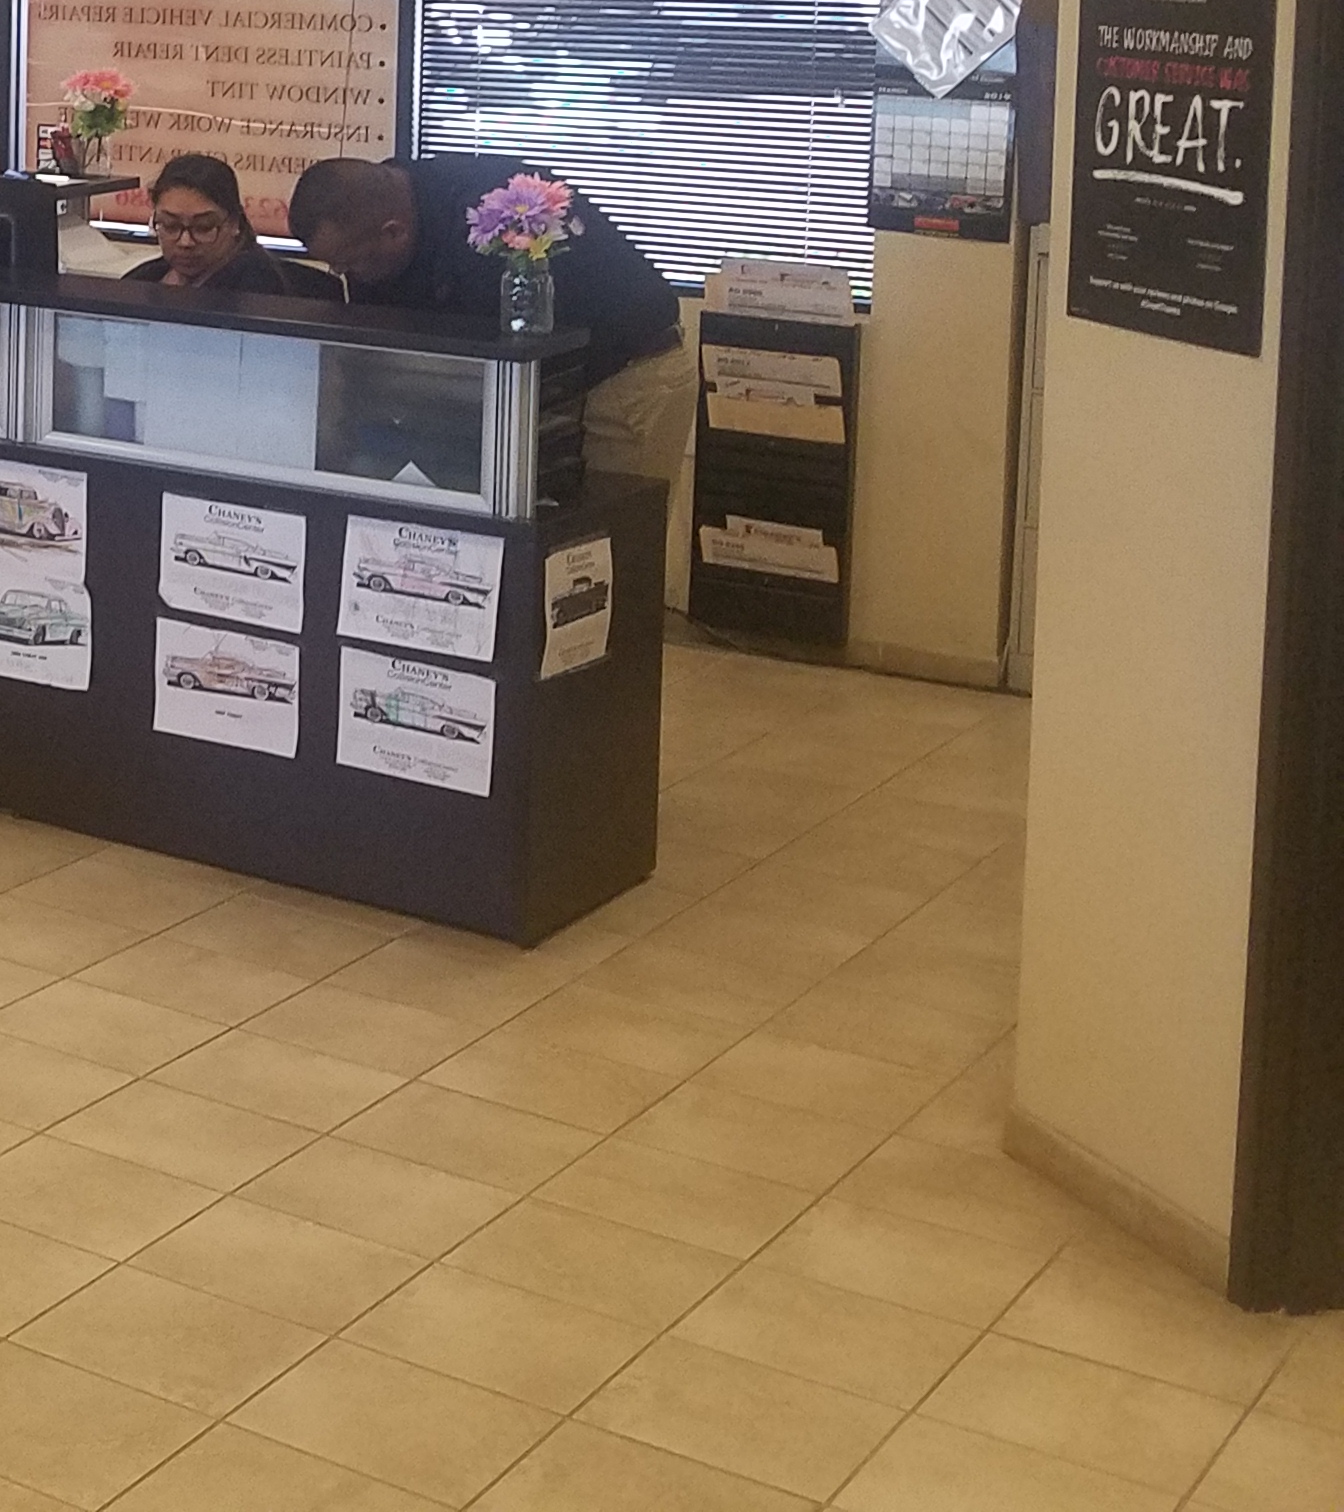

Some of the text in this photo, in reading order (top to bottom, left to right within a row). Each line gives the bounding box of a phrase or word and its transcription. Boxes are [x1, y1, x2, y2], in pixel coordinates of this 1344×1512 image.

[1098, 25, 1254, 60] THE WORKMANSHIP AND
[1095, 85, 1245, 173] GREAT.
